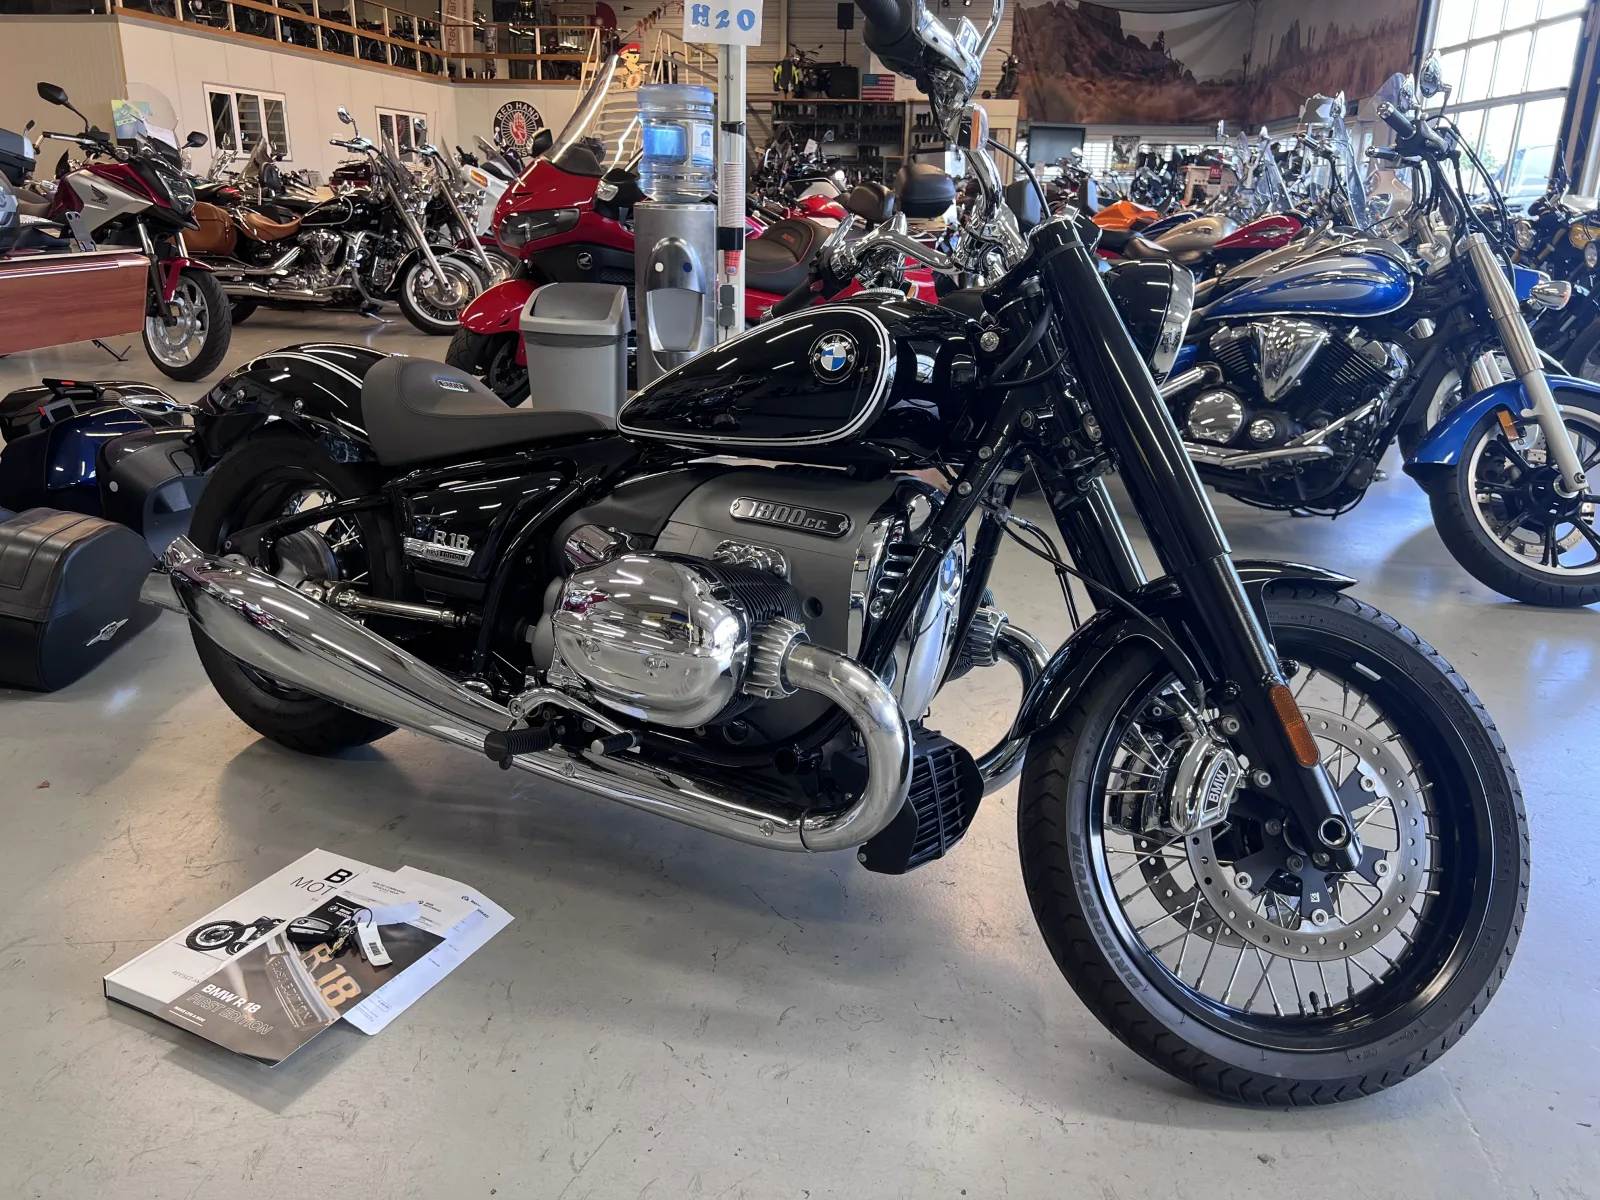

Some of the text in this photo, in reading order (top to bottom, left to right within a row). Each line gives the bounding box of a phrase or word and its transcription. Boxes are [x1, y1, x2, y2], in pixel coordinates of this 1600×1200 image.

[496, 102, 540, 121] RED HAND
[748, 501, 828, 530] 1800cc
[1208, 769, 1227, 803] BMW
[290, 876, 337, 896] MOT
[1070, 831, 1144, 990] BRIDGESTONE
[201, 983, 239, 1003] BMW
[186, 992, 273, 1035] FIRST EDITION
